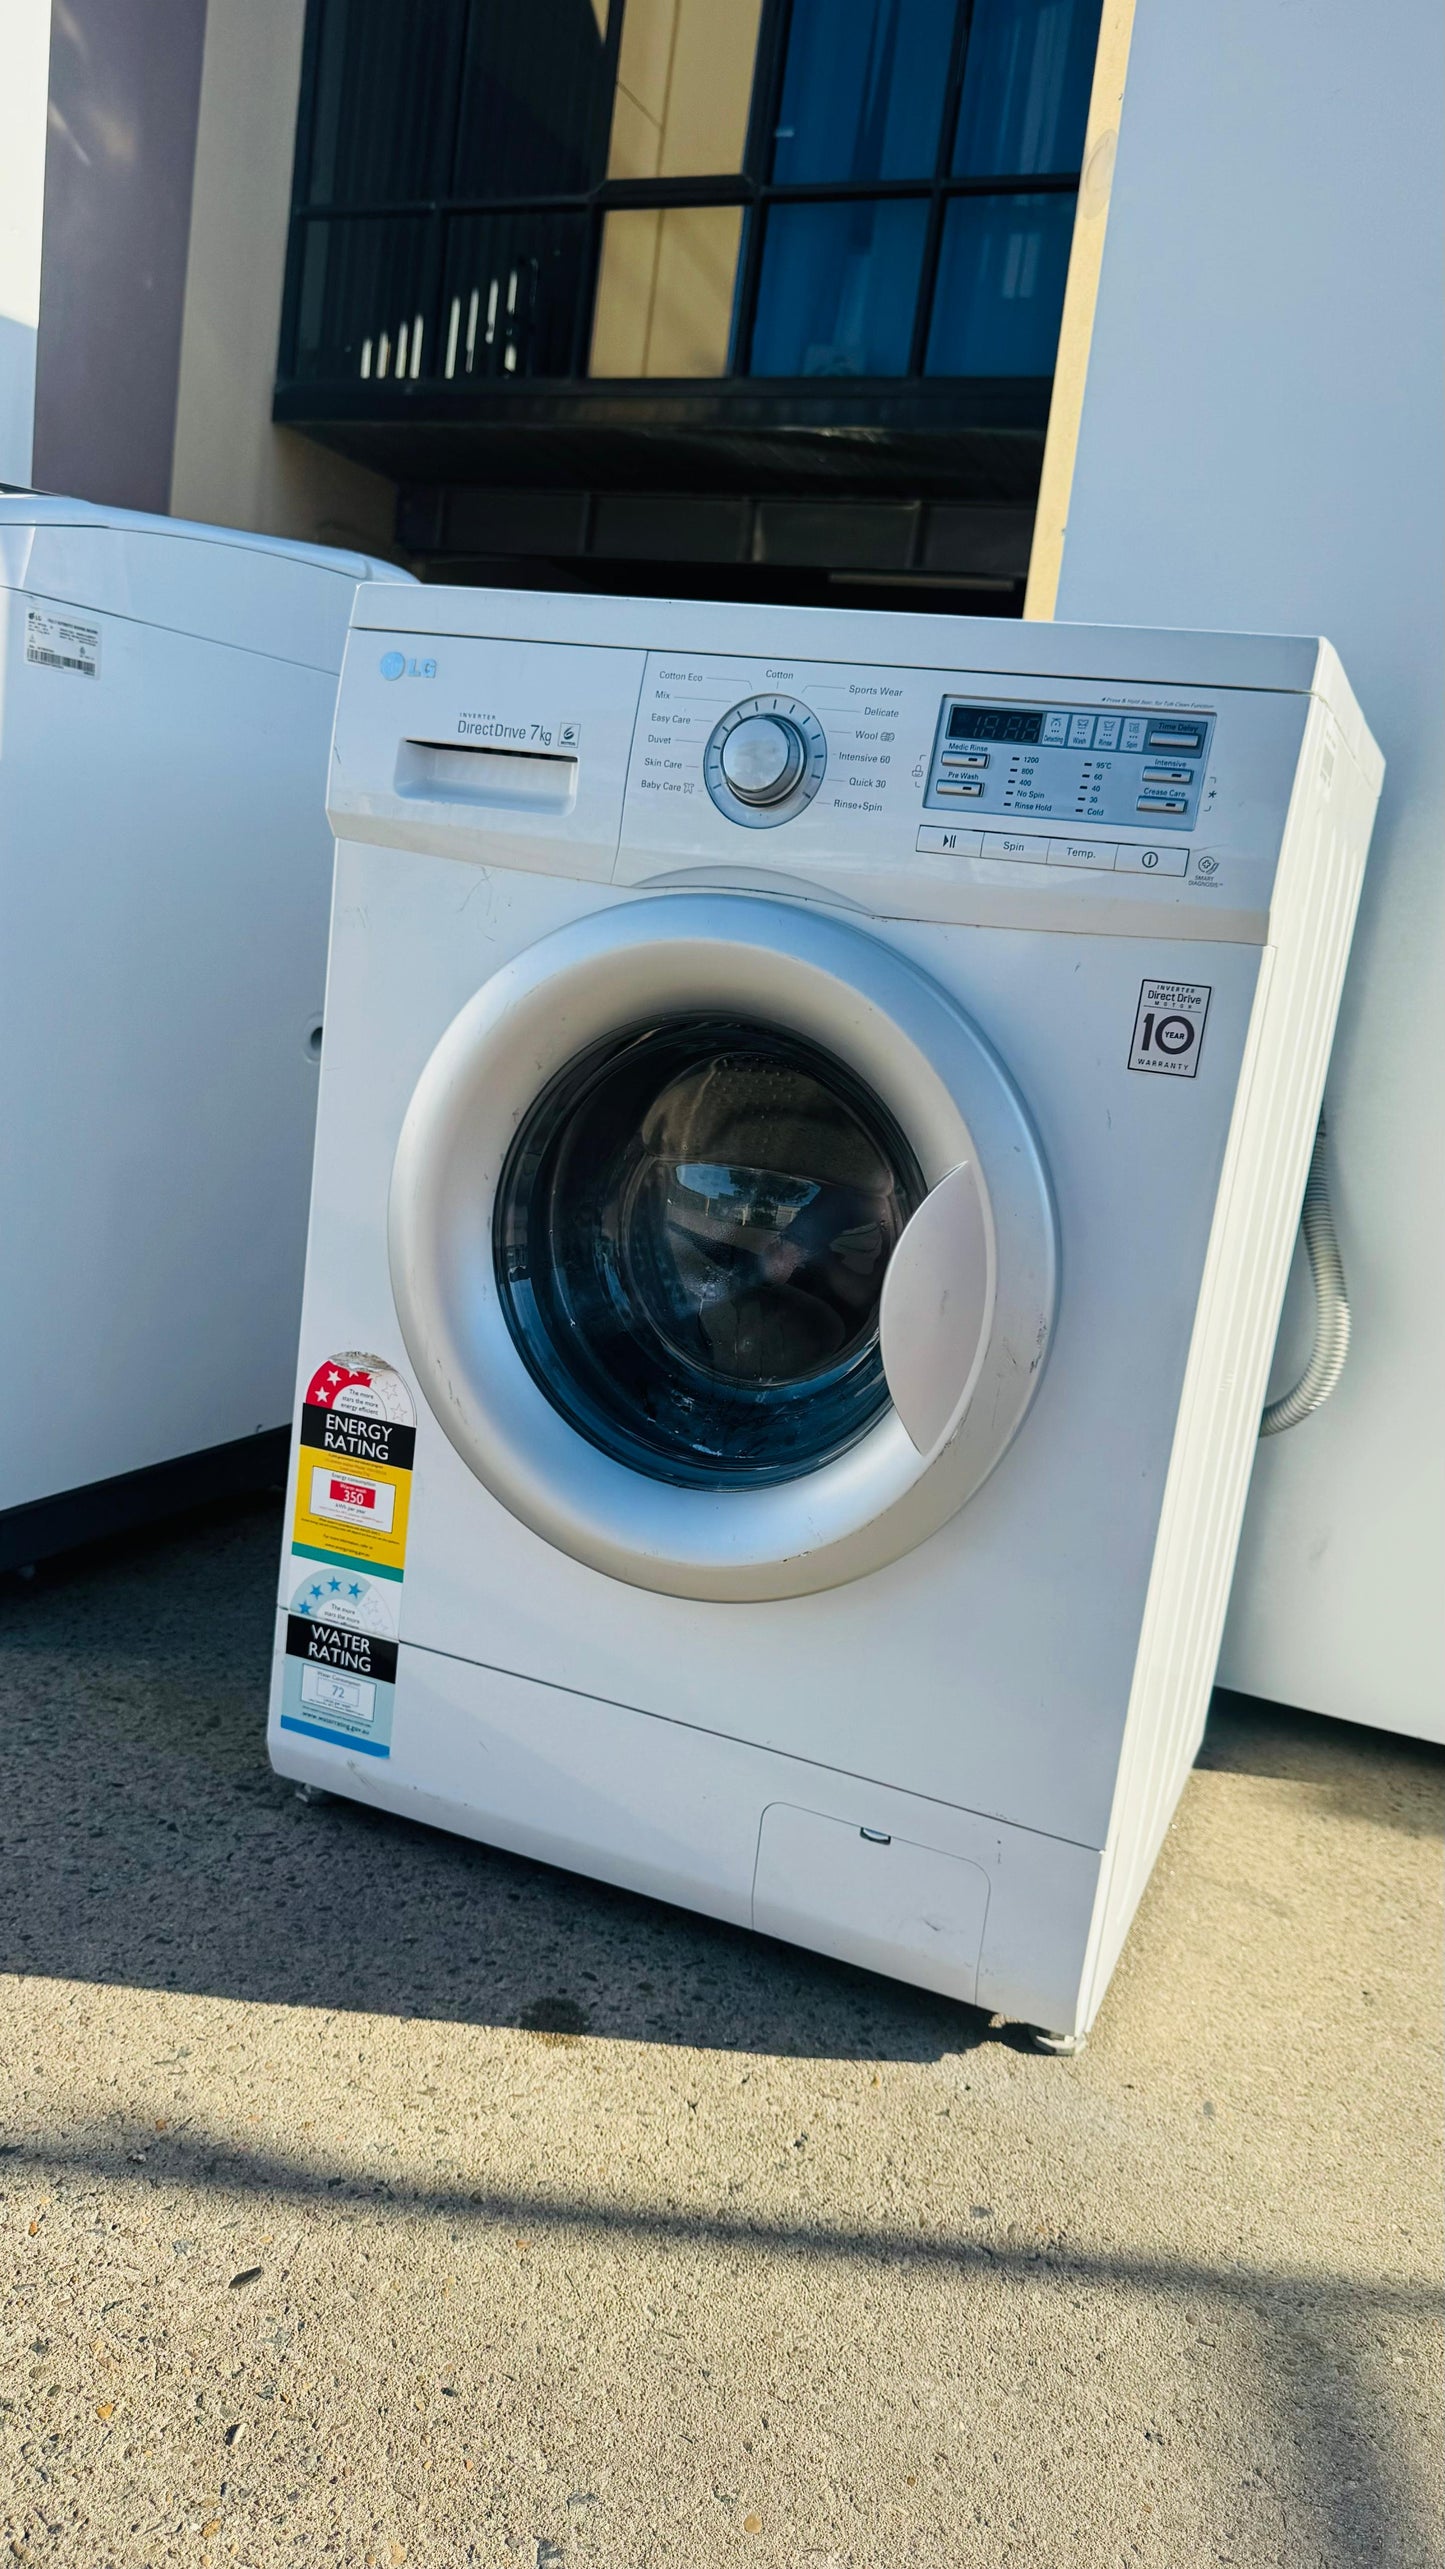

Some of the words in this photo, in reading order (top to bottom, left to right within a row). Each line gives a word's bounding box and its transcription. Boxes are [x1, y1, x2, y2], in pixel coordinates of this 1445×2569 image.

[407, 658, 437, 679] LG
[659, 671, 686, 681] Cotton
[687, 673, 703, 682] Eco
[765, 670, 794, 680] Cotton
[655, 690, 670, 699] Mix
[848, 685, 878, 697] Sports
[879, 687, 903, 698] Wear
[459, 712, 496, 720] INVERTER
[864, 707, 900, 718] Delicate
[651, 713, 672, 725] Easy
[673, 715, 691, 724] Care
[1159, 722, 1177, 730] Time
[1178, 724, 1199, 733] Delay
[647, 735, 671, 745] Duvet
[855, 730, 878, 741] Wool
[949, 743, 968, 751] Medic
[1126, 741, 1138, 749] Spin
[838, 751, 873, 764] Intensive
[873, 755, 891, 765] 60
[1154, 759, 1187, 768] Intensive
[644, 758, 663, 768] Skin
[663, 760, 682, 770] Care
[641, 780, 662, 792] Baby
[662, 782, 682, 792] Care
[849, 777, 874, 788] Quick
[875, 779, 887, 788] 30
[1028, 791, 1045, 799] Spin
[1143, 787, 1168, 797] Crease
[1169, 789, 1186, 798] Care
[833, 799, 883, 812] Rinse+Spin
[1014, 802, 1034, 810] Rinse
[1035, 803, 1052, 811] Hold
[1087, 808, 1104, 816] Cold
[1003, 841, 1025, 852] Spin
[1066, 847, 1096, 859] Temp.
[1157, 984, 1195, 994] INVERTER
[1147, 990, 1175, 1001] Direct
[1177, 993, 1202, 1004] Drive
[1154, 1001, 1192, 1009] MOTOR
[1141, 1013, 1195, 1055] 10
[1165, 1031, 1185, 1040] YEAR
[1138, 1058, 1189, 1071] WARRANTY
[341, 1403, 357, 1411] energy
[325, 1413, 393, 1443] ENERGY
[324, 1431, 389, 1461] RATING
[331, 1472, 347, 1481] Energy
[343, 1489, 364, 1505] 350
[332, 1603, 341, 1611] The
[342, 1607, 355, 1615] more
[311, 1624, 371, 1655] WATER
[308, 1641, 372, 1673] RATING
[332, 1685, 345, 1699] 72
